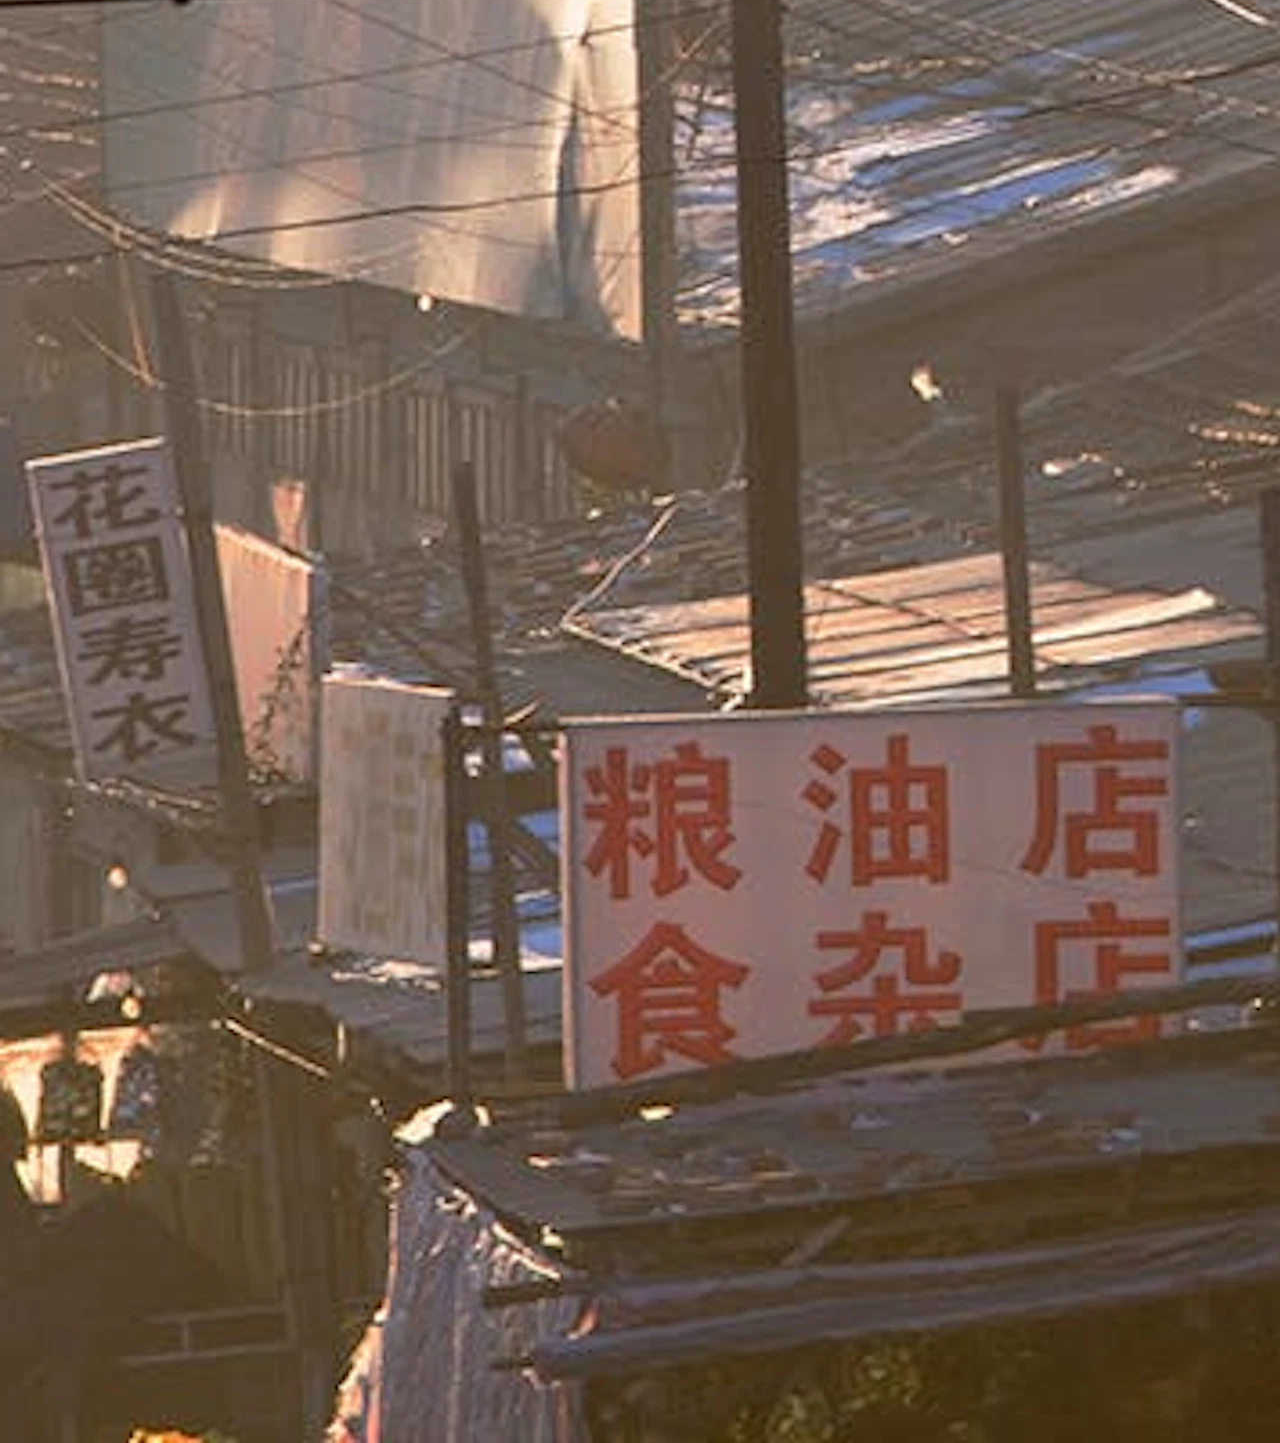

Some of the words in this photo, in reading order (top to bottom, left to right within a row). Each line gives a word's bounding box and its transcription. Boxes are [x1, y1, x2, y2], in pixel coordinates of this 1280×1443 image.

[48, 462, 196, 763] 花圈寿衣
[583, 724, 1170, 901] 粮油店
[587, 901, 1171, 1082] 食杂店
